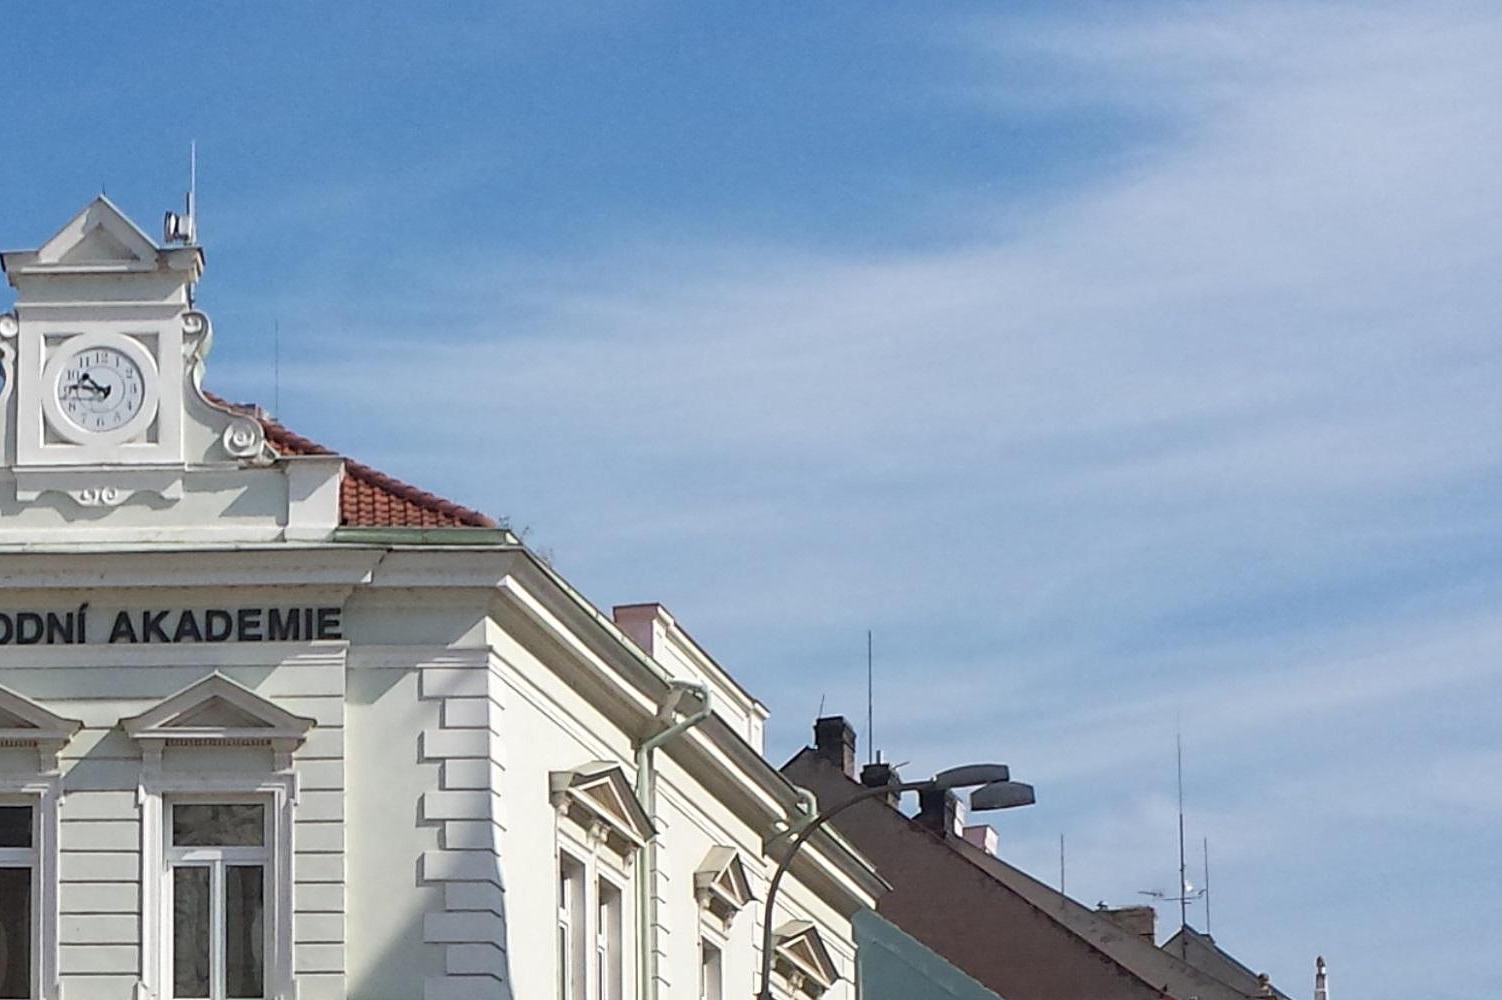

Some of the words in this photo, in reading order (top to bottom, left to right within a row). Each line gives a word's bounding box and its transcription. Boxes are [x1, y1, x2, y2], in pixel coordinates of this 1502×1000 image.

[79, 356, 90, 369] 11
[96, 351, 108, 364] 12
[67, 369, 80, 381] 10
[125, 367, 133, 379] 2
[108, 607, 342, 643] AKADEMIE
